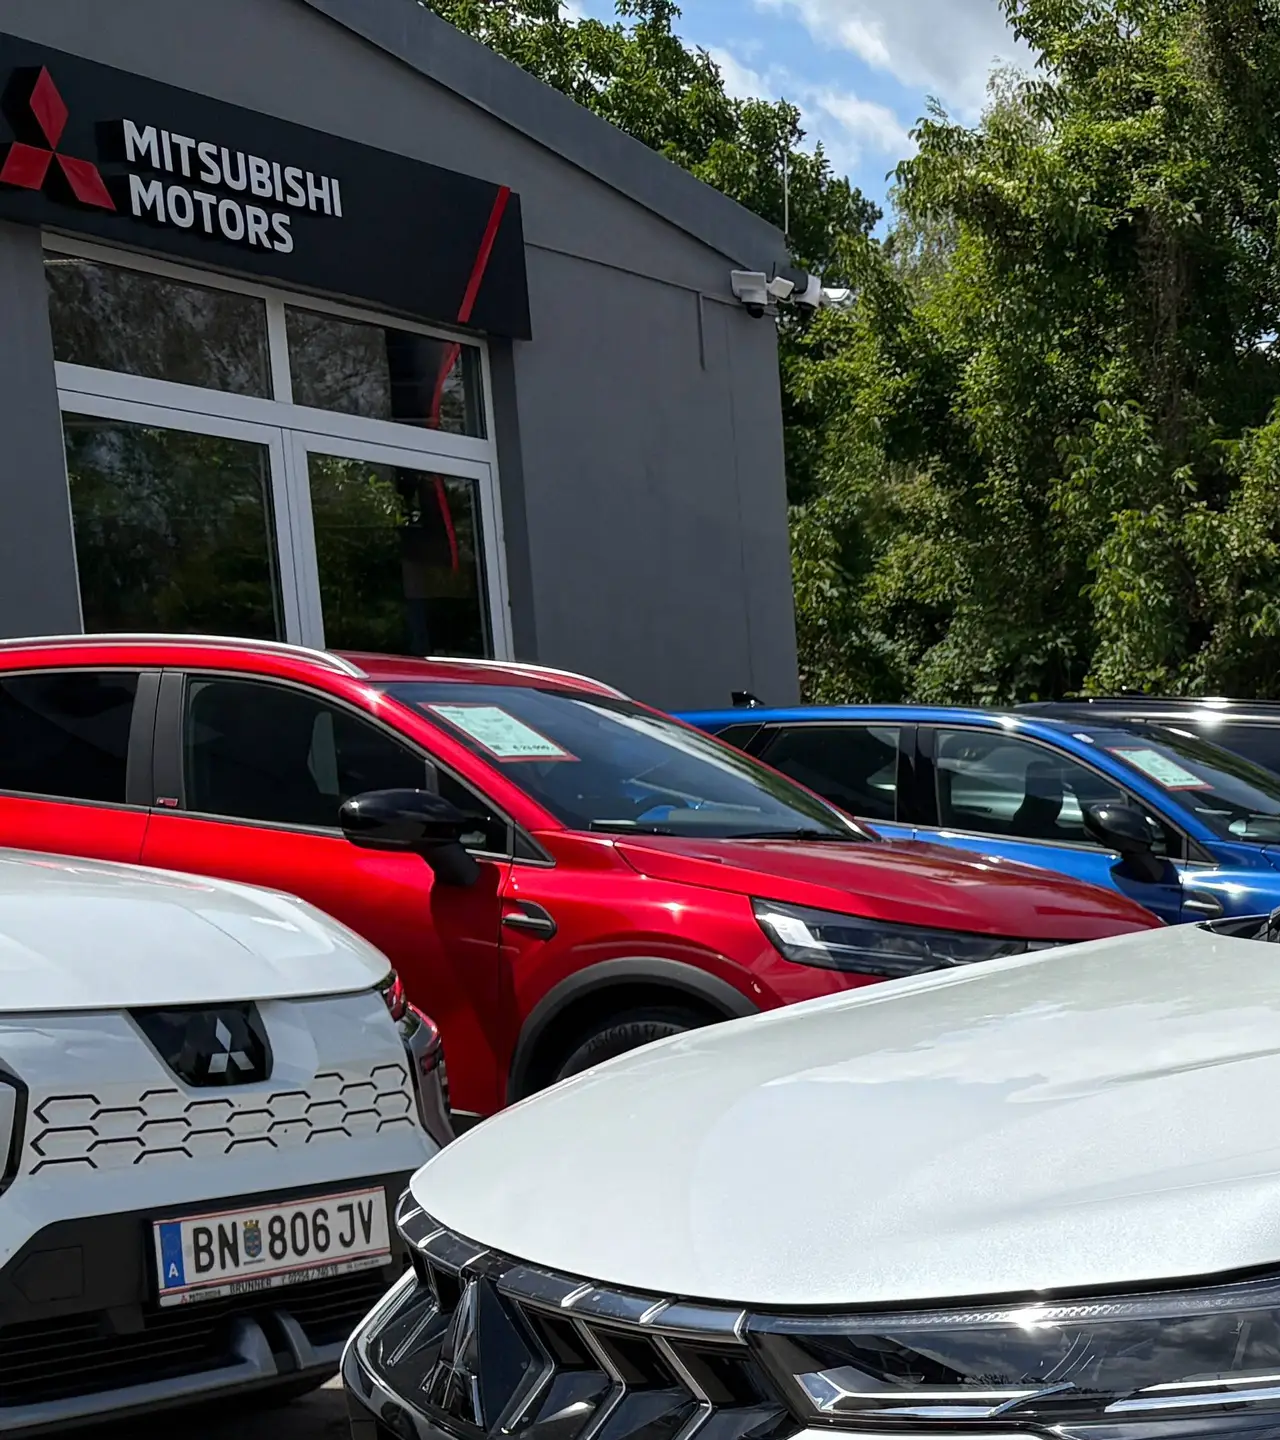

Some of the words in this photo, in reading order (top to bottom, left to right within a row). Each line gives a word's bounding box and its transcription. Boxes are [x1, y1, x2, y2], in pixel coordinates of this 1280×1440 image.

[122, 118, 342, 218] MITSUBISHI
[129, 174, 294, 253] MOTORS
[168, 1263, 179, 1278] A
[193, 1221, 240, 1274] BN
[268, 1208, 331, 1260] 806
[337, 1199, 373, 1248] JV
[230, 1278, 272, 1294] BRUNNER
